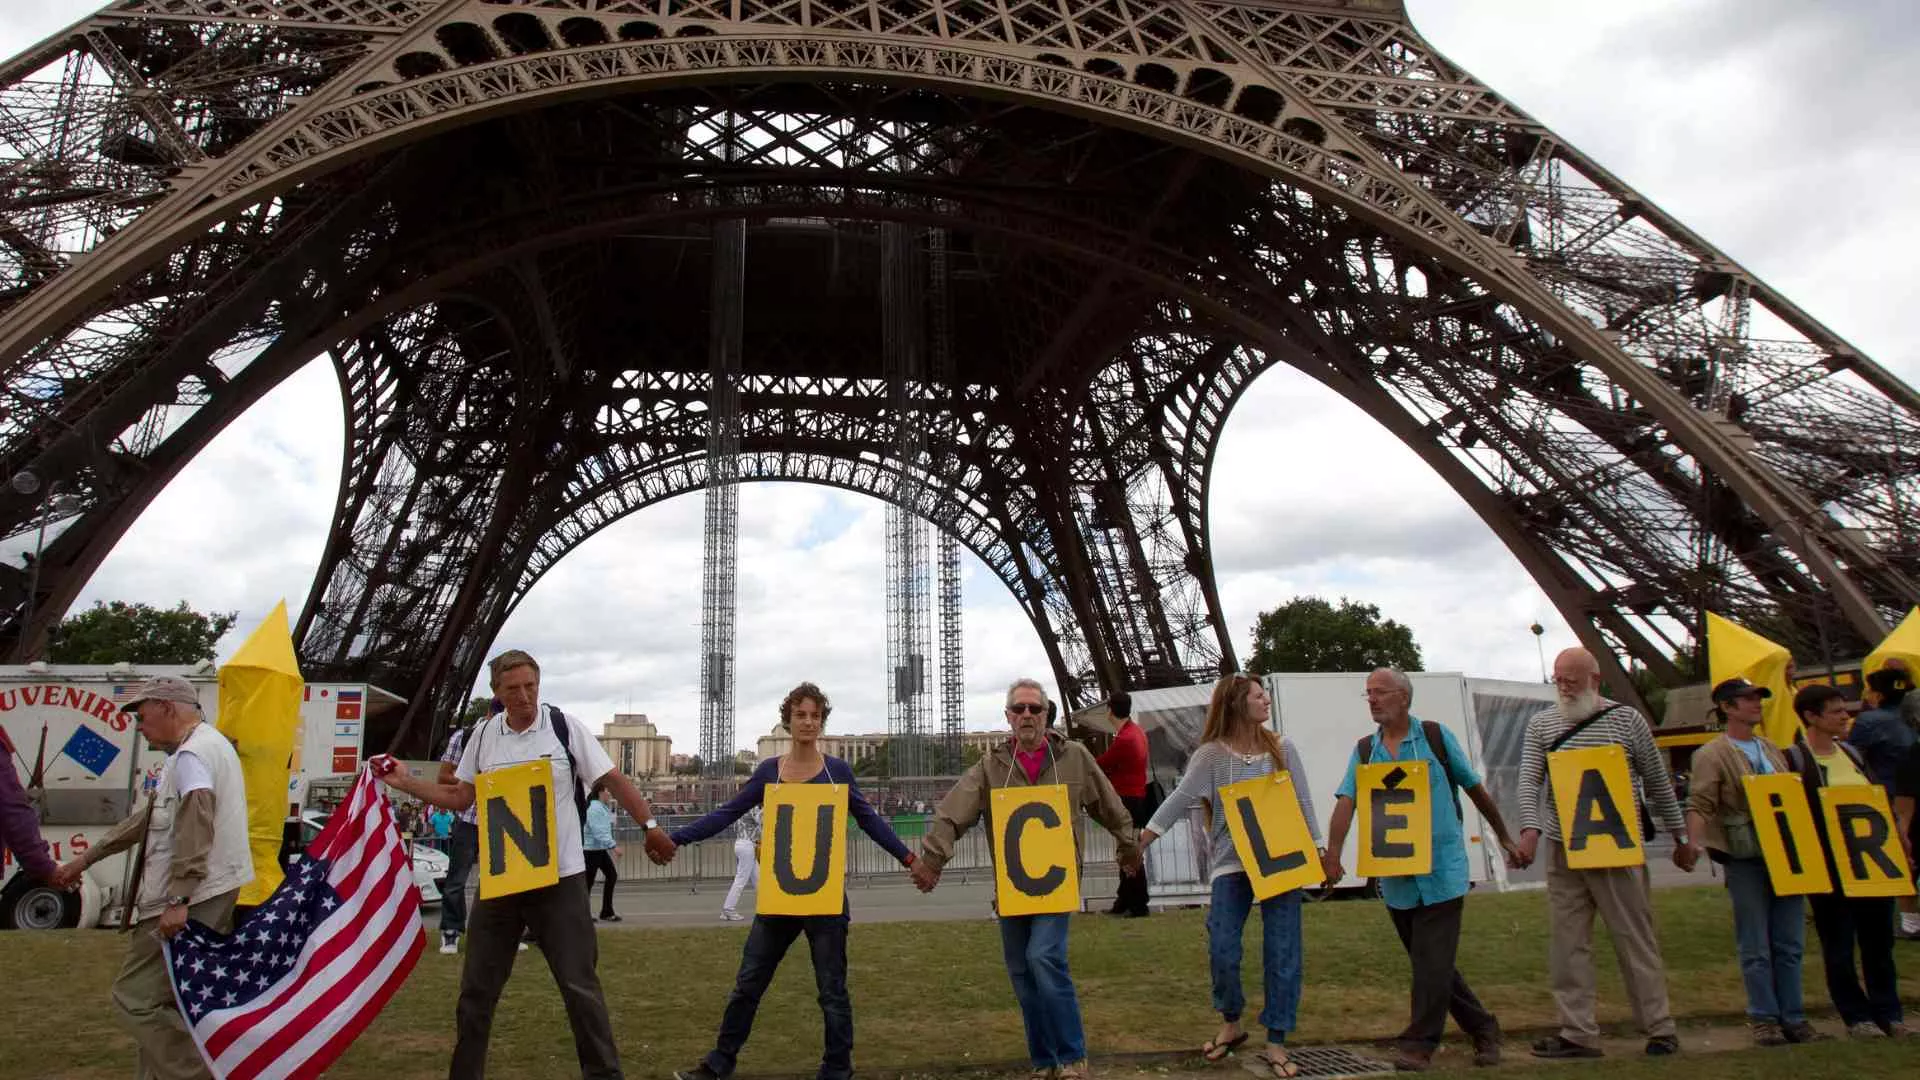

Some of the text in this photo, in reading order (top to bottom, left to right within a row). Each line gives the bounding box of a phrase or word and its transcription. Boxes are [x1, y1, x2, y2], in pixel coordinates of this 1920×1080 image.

[487, 785, 550, 876] N
[774, 805, 834, 896] U
[1004, 802, 1067, 897] C
[1237, 797, 1307, 877] L
[1371, 767, 1416, 858] É
[1568, 769, 1636, 851] A
[1836, 804, 1904, 881] R
